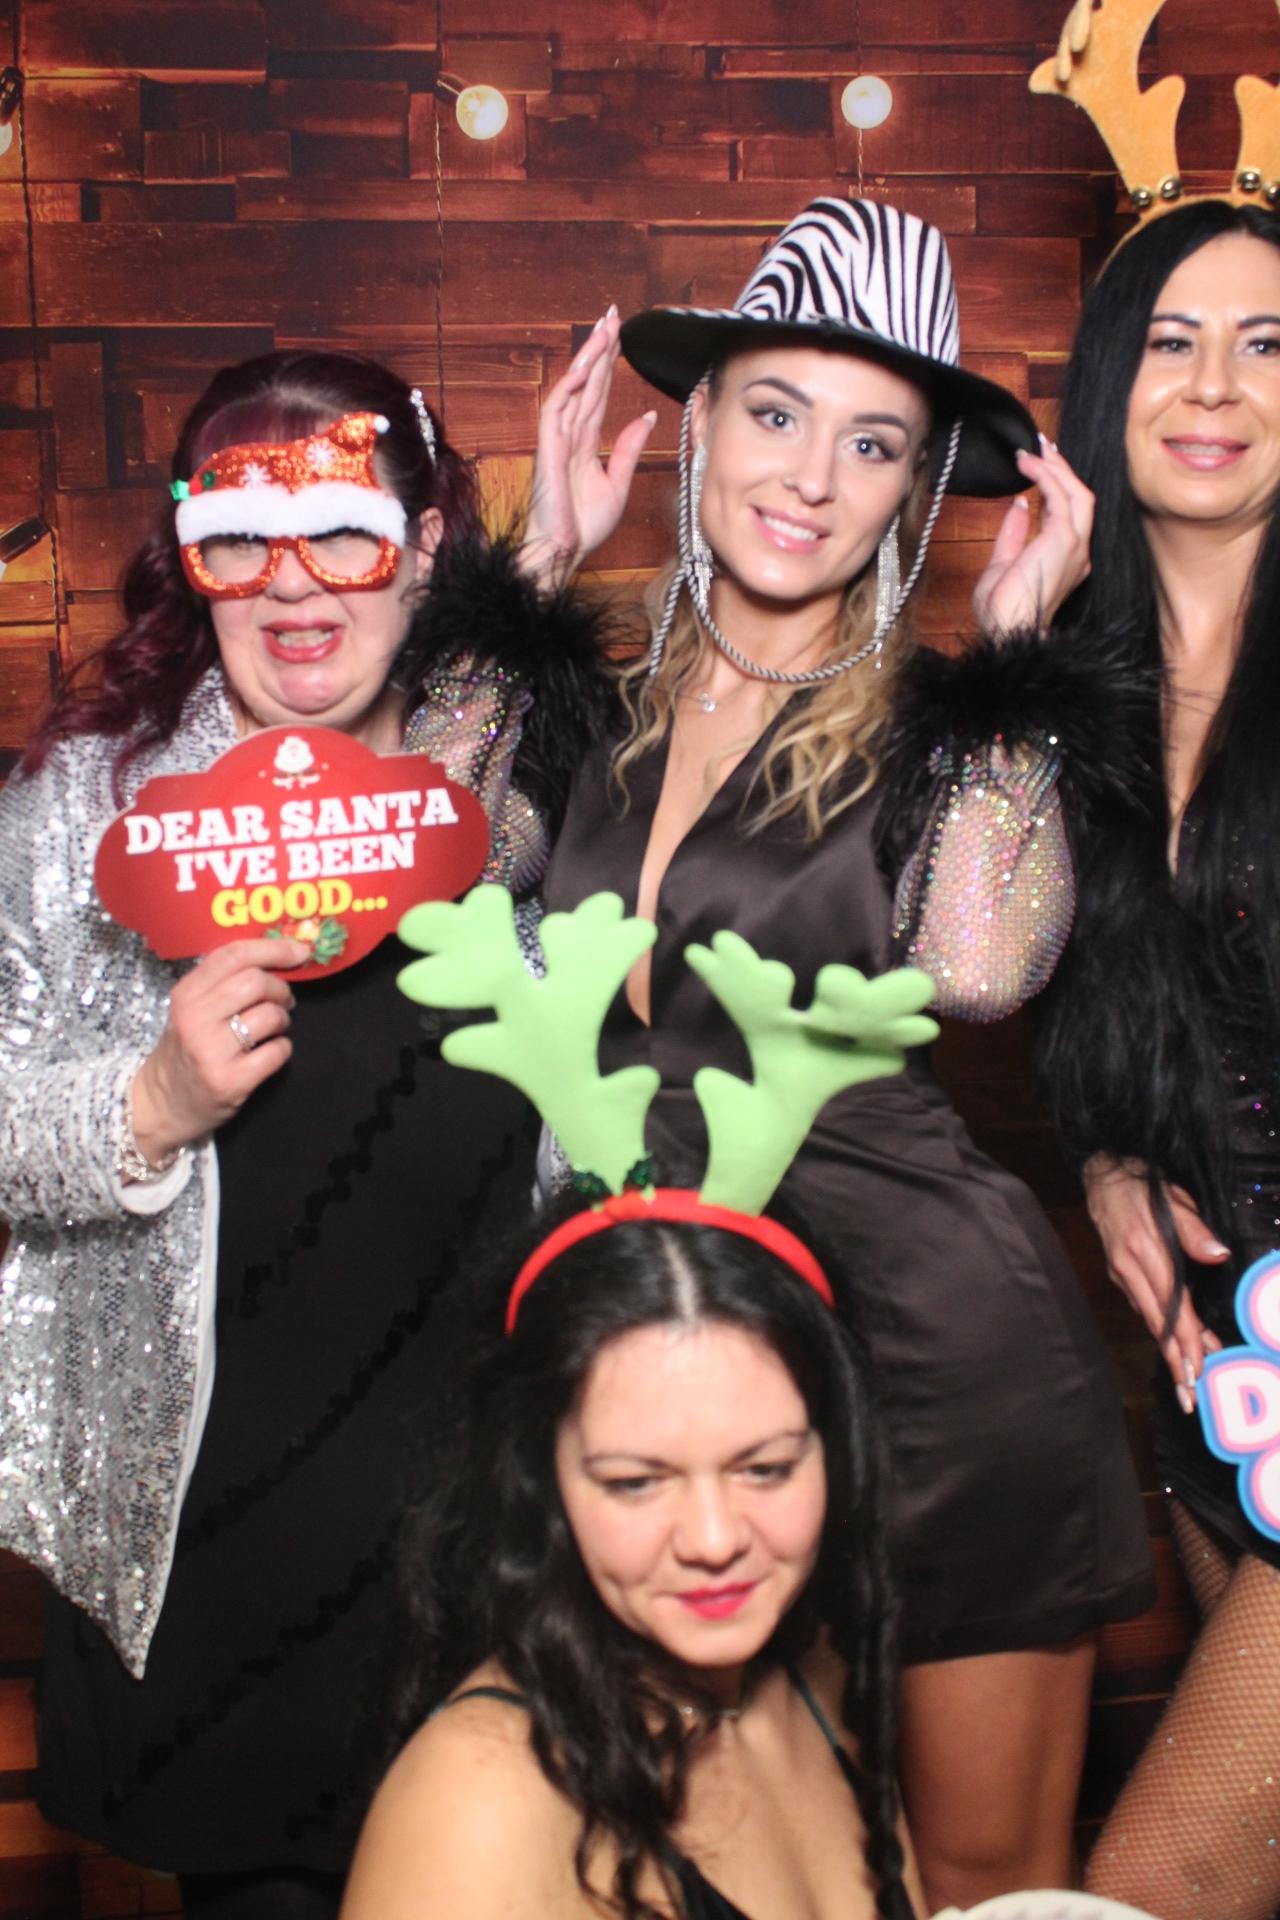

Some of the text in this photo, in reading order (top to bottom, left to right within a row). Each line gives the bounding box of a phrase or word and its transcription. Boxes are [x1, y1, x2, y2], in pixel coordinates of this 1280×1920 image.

[125, 788, 459, 855] DEAR SANTA
[175, 832, 417, 892] I'VE BEEN
[210, 878, 388, 927] GOOD...
